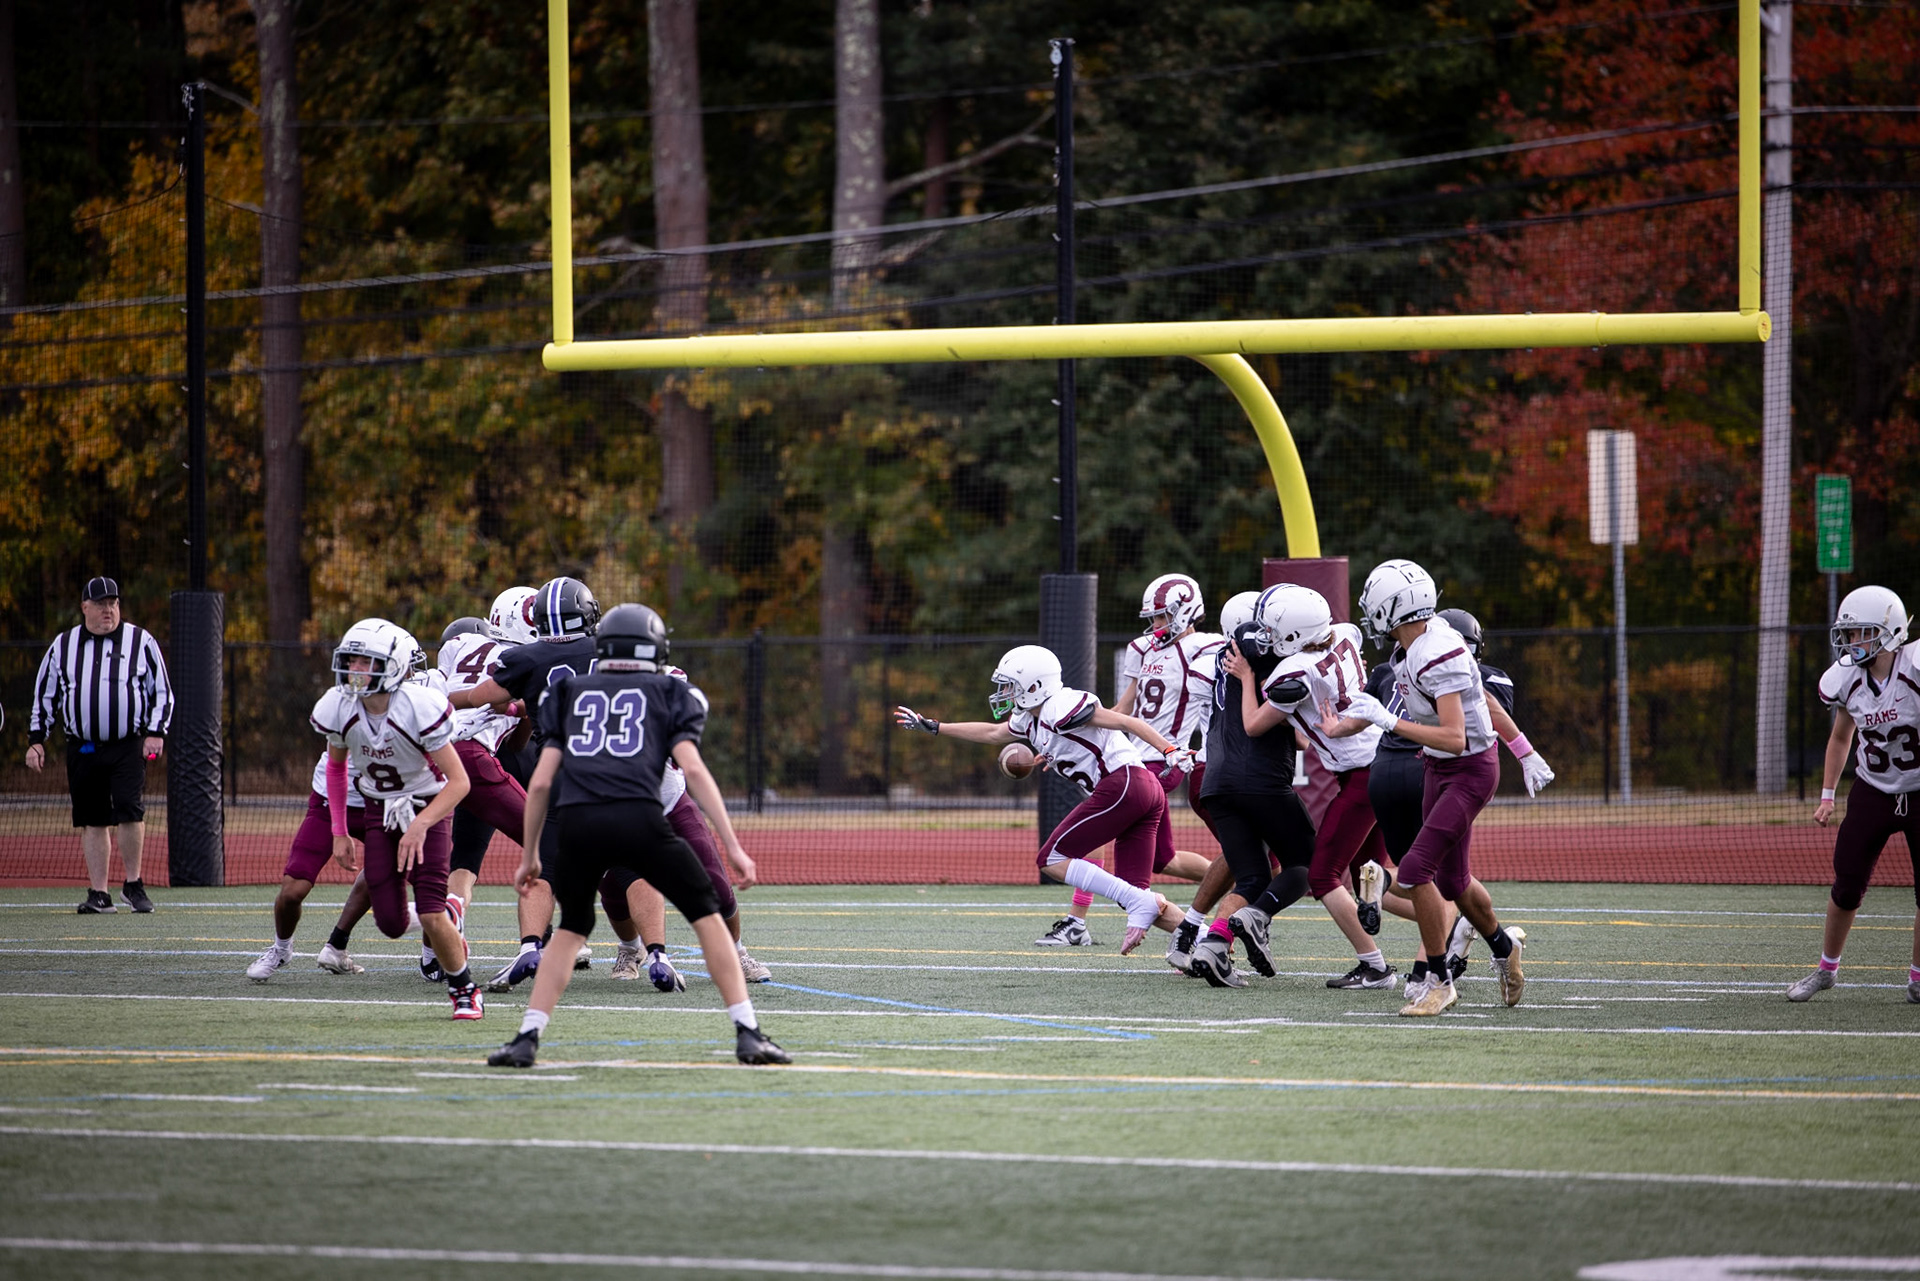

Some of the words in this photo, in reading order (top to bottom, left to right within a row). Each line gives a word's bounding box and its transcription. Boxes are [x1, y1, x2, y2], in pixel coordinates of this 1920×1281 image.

[456, 642, 499, 684] 4
[1143, 663, 1163, 675] RAMS
[1315, 637, 1366, 713] 77
[567, 688, 647, 757] 33
[1865, 708, 1898, 726] RAMS
[362, 745, 394, 760] RAMS
[1861, 724, 1920, 773] 63
[367, 762, 405, 792] 8
